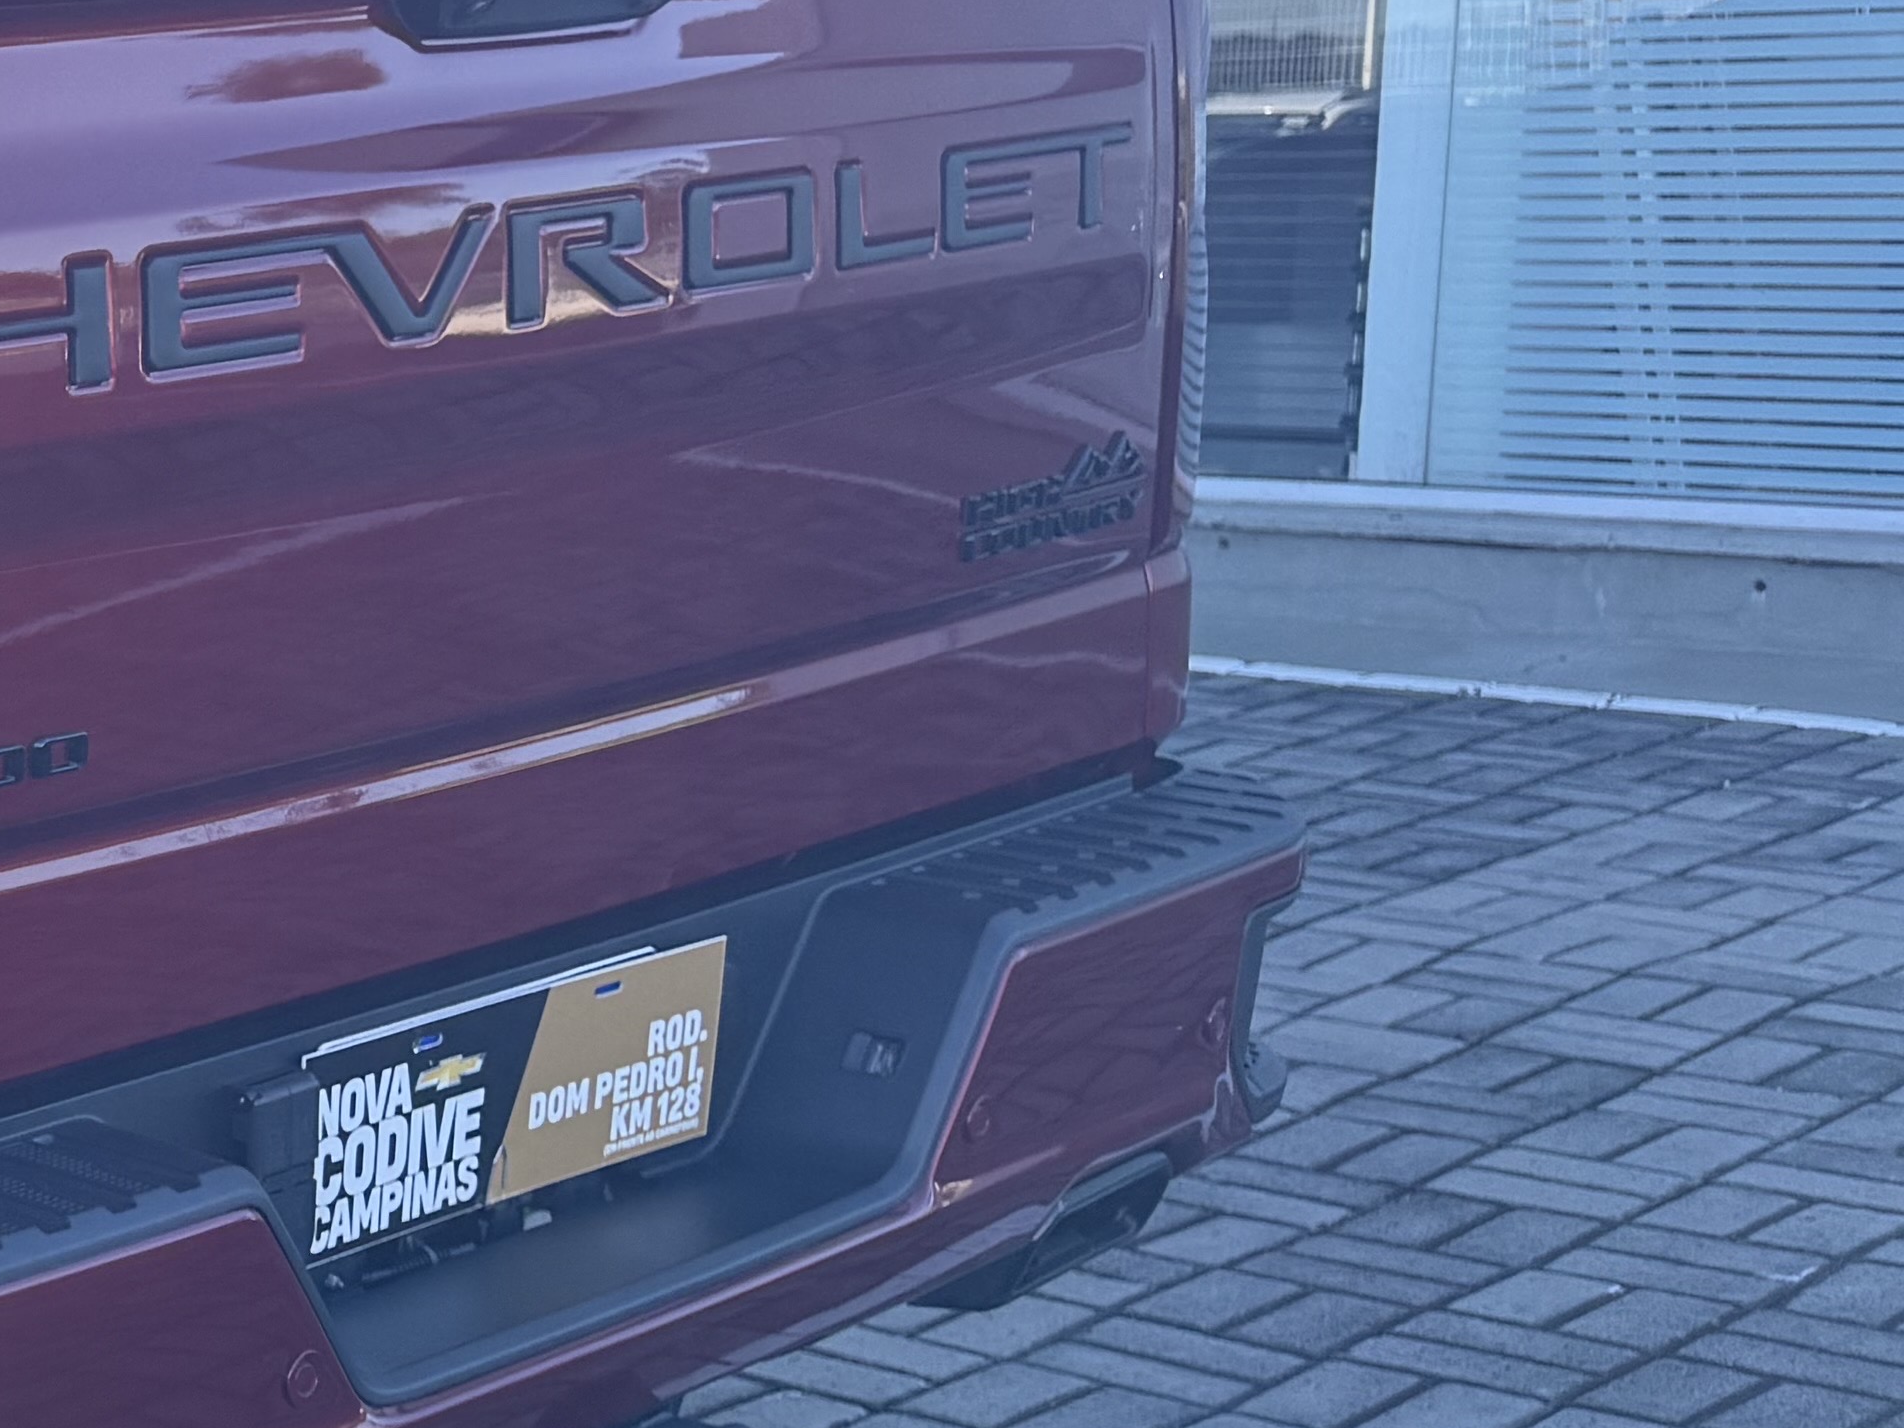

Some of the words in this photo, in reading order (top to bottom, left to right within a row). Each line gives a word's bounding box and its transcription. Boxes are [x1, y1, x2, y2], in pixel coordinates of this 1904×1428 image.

[647, 1009, 708, 1058] ROD.
[318, 1062, 412, 1141] NOVA
[528, 1077, 590, 1130] DOM
[594, 1050, 684, 1110] PEDRO
[688, 1045, 704, 1084] I,
[610, 1095, 653, 1141] KM
[657, 1083, 701, 1126] 128
[313, 1087, 485, 1206] CODIVE
[310, 1155, 479, 1255] CAMPINAS
